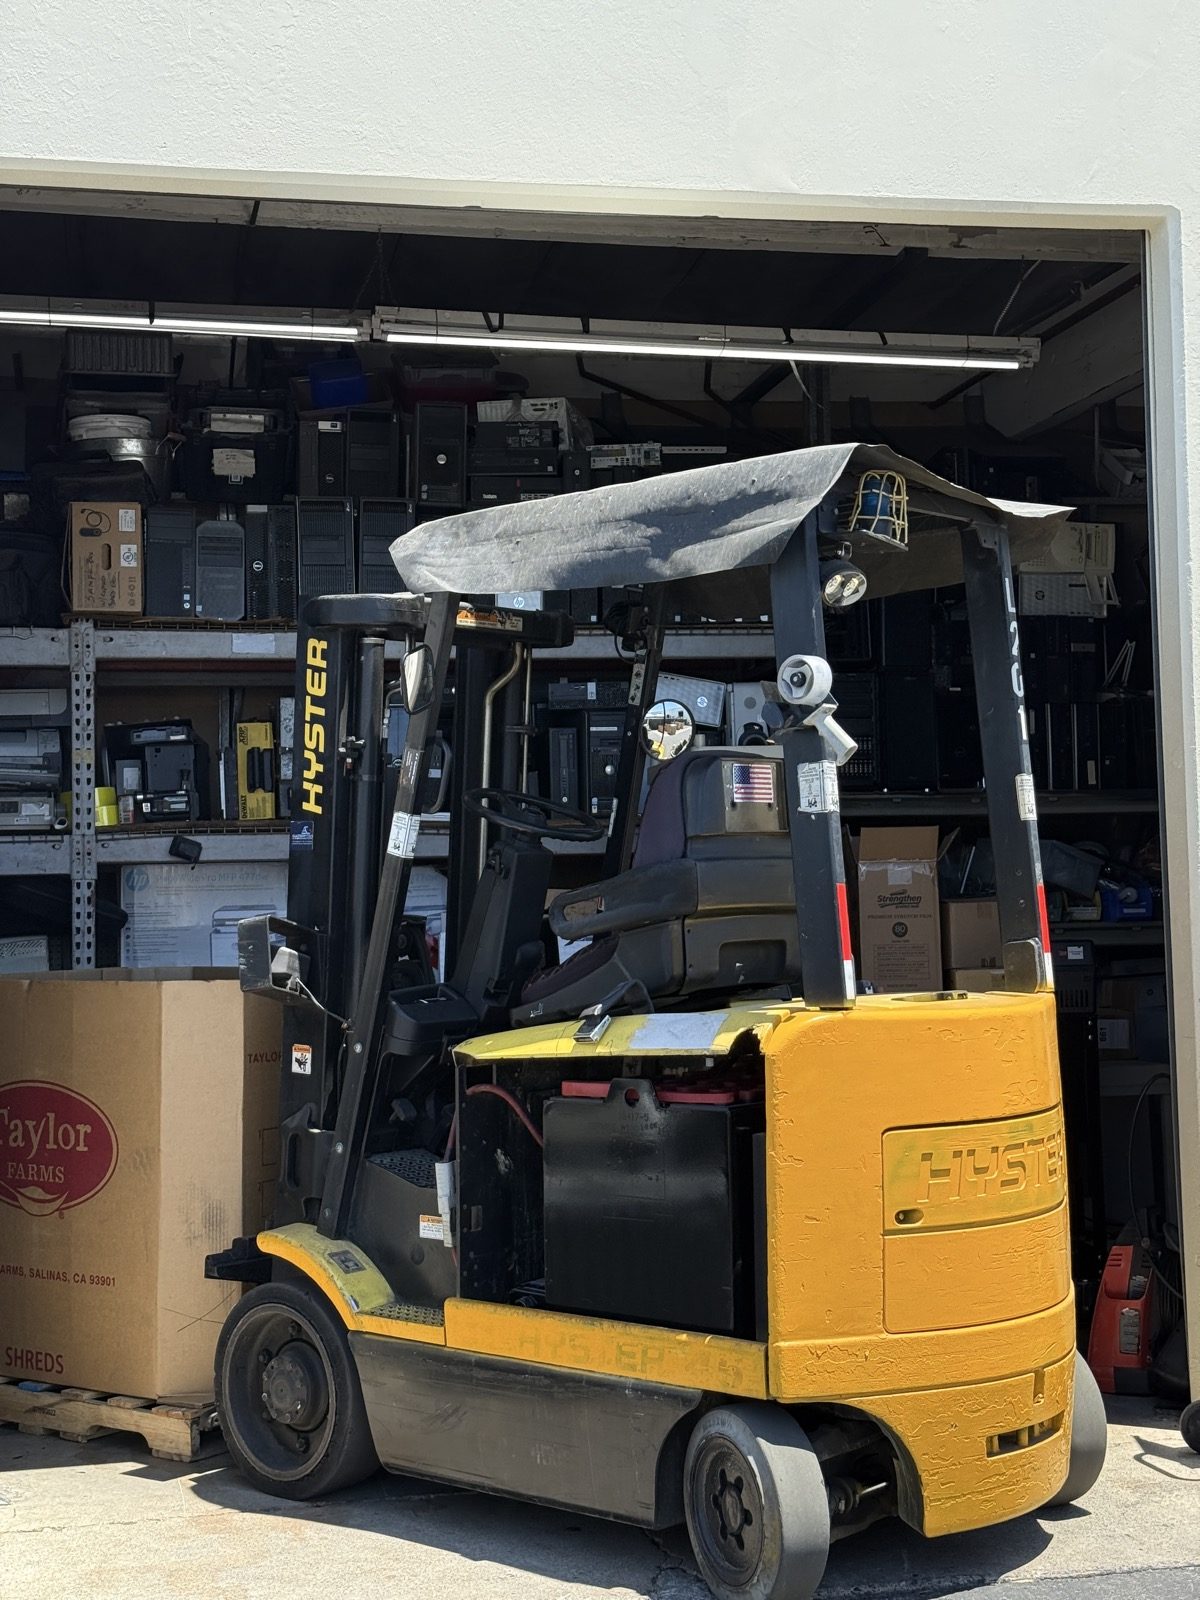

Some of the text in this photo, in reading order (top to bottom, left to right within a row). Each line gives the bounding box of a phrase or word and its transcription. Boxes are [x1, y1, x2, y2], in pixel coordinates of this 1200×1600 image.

[301, 637, 328, 815] HYSTER
[127, 868, 149, 891] hp
[6, 1162, 65, 1184] FARMS
[29, 1268, 71, 1283] SALINAS,
[73, 1272, 87, 1284] CA
[89, 1274, 116, 1287] 93901
[5, 1347, 64, 1374] SHREDS
